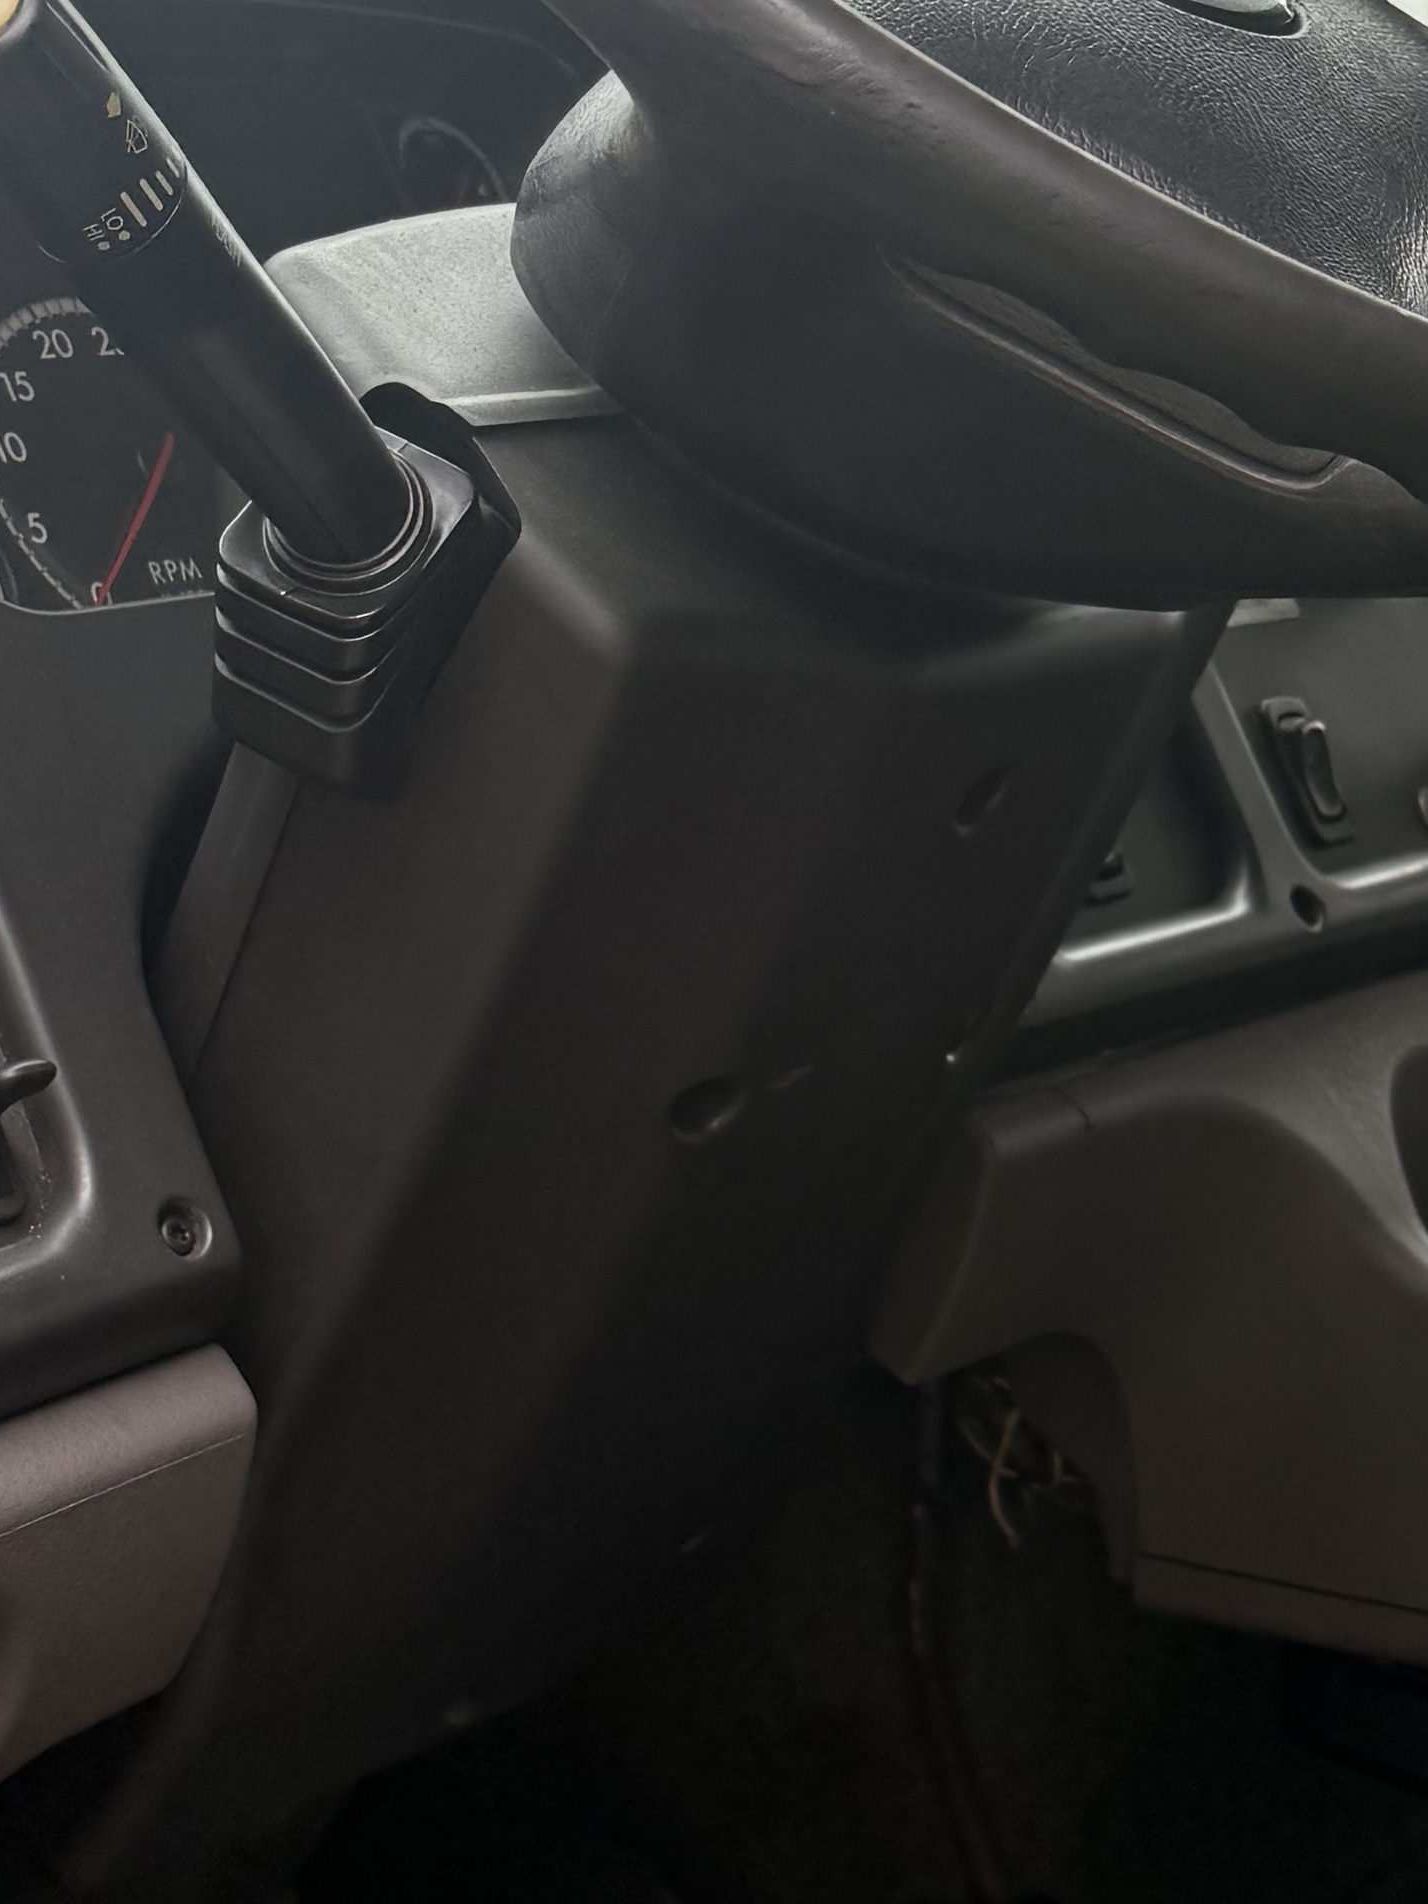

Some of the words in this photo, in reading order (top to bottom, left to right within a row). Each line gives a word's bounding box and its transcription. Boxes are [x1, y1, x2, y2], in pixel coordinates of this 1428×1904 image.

[82, 223, 105, 242] HI
[100, 207, 125, 232] LO
[32, 328, 74, 360] 20
[91, 326, 125, 356] 2
[27, 512, 48, 544] 5
[148, 557, 204, 586] RPM
